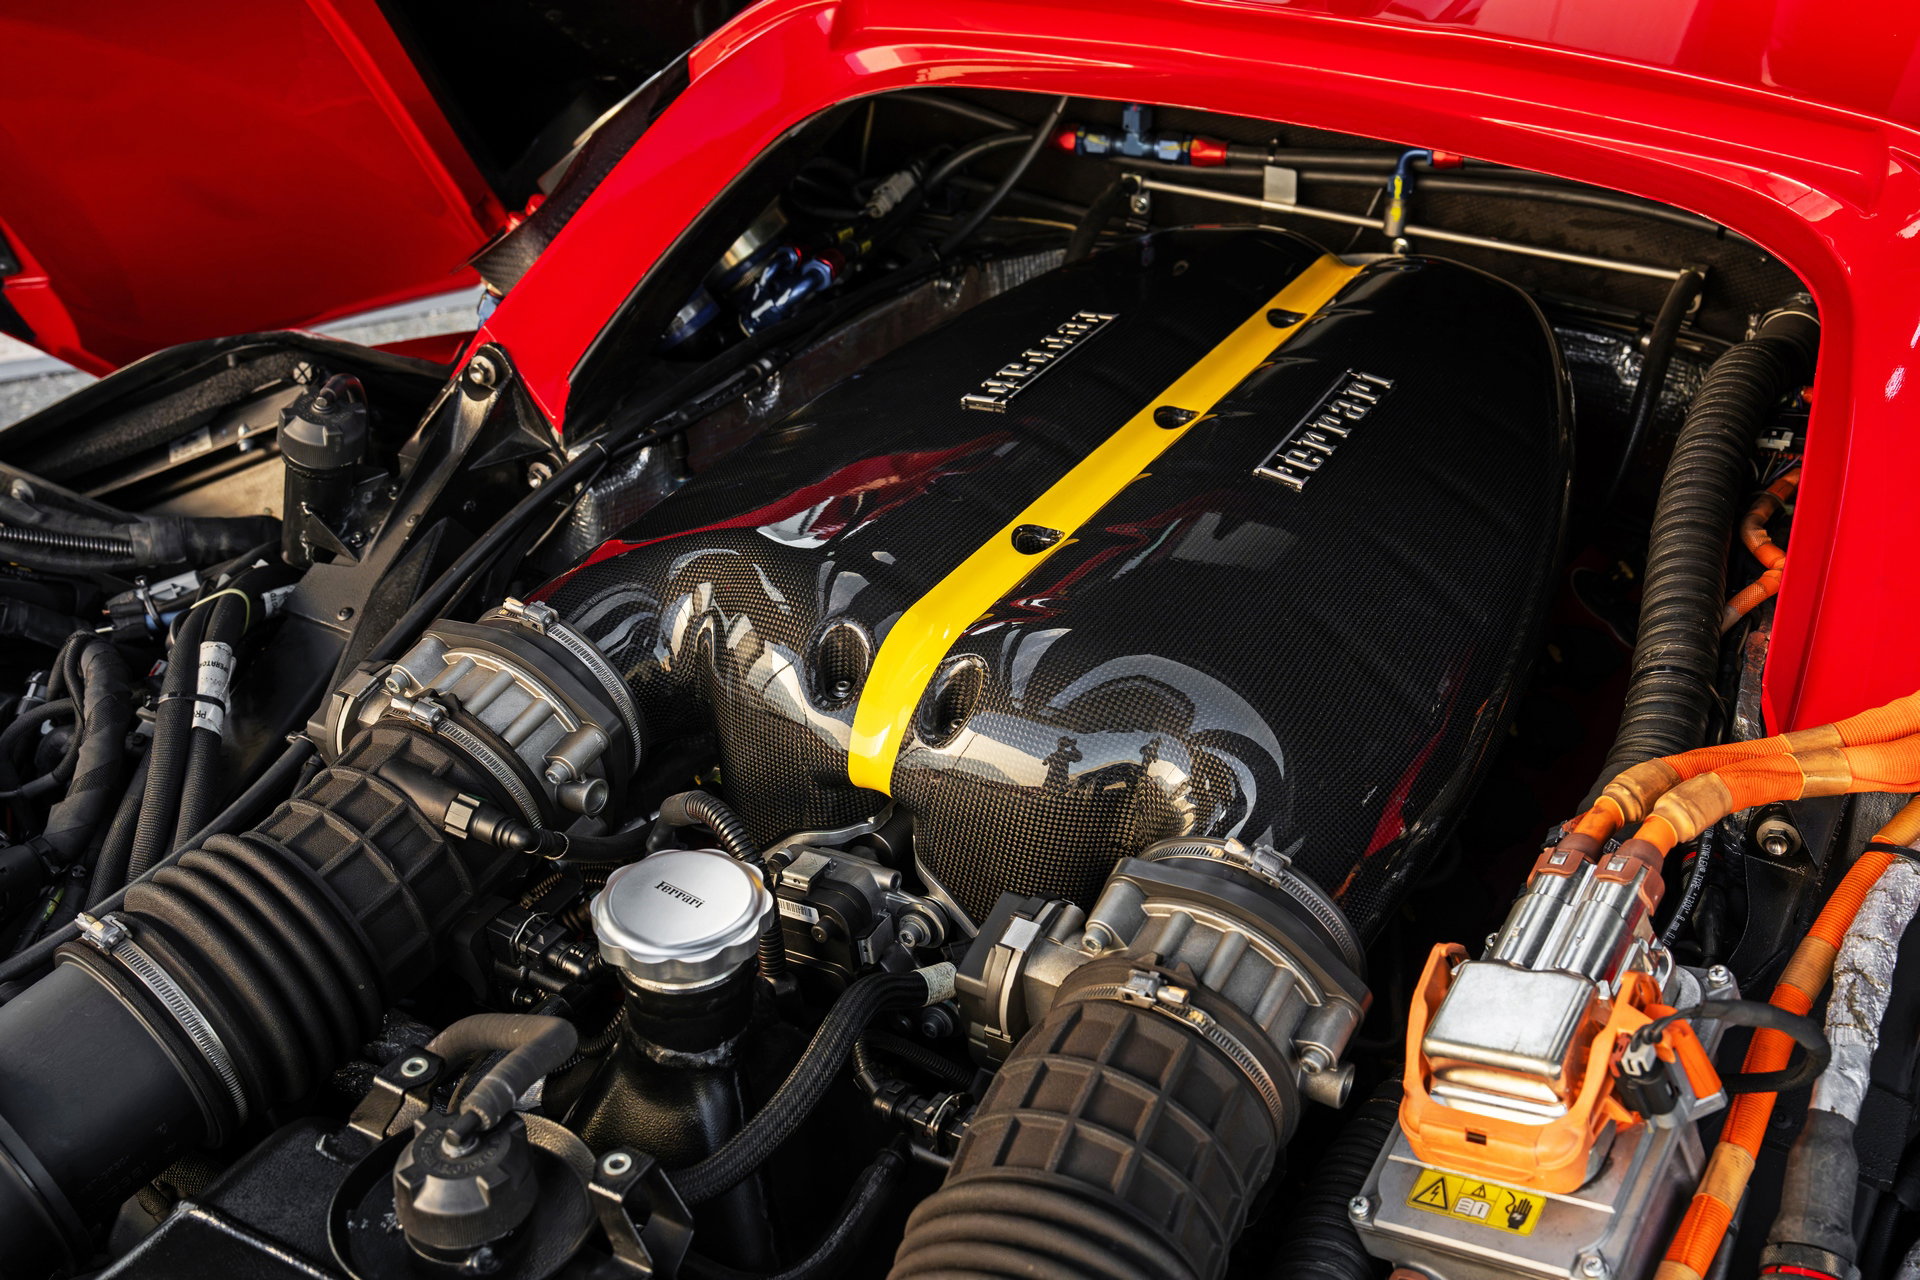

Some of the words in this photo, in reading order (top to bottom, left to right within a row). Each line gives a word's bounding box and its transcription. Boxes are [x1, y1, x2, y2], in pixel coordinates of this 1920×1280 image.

[961, 310, 1119, 413] Ferrari
[1252, 368, 1396, 492] Ferrari
[654, 880, 705, 908] Ferrari
